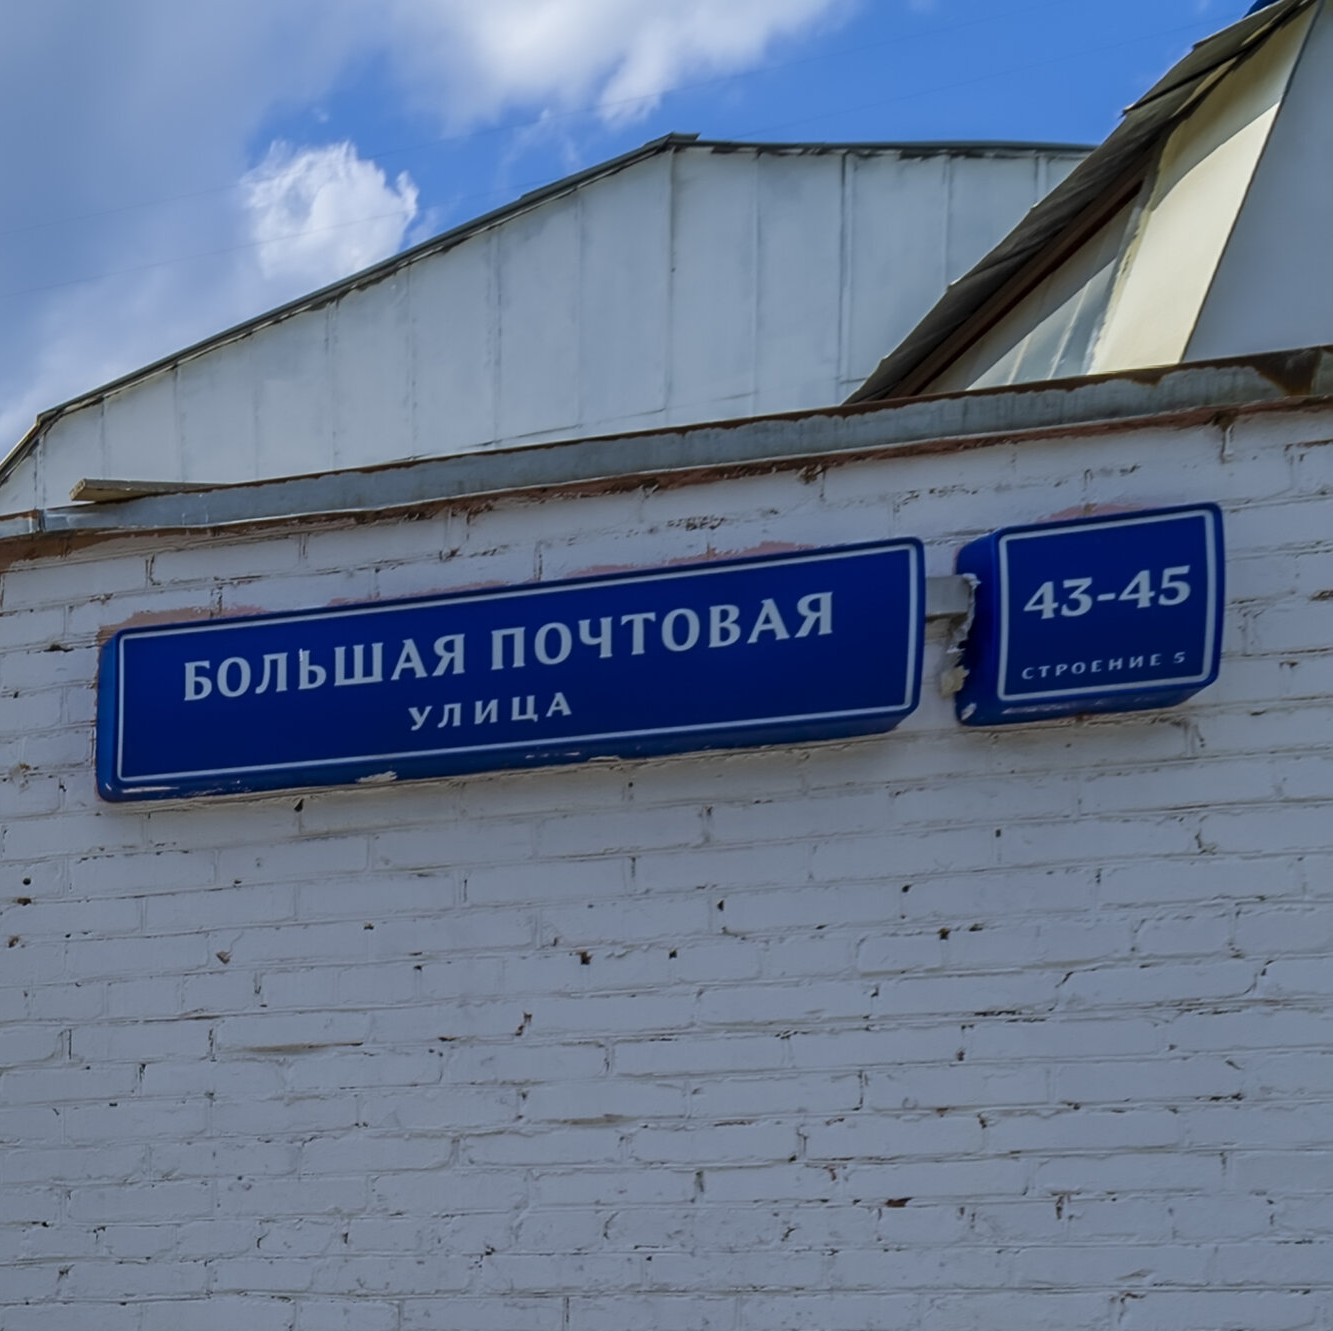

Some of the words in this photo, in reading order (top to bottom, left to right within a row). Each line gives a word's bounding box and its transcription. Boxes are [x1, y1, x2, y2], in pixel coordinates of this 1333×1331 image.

[1023, 565, 1191, 619] 43-45
[183, 634, 467, 701] БОЛЬШАЯ
[490, 592, 835, 670] ПОЧТОВАЯ
[1021, 653, 1162, 680] СТРОЕНИЕ
[1172, 651, 1186, 664] 5
[408, 692, 573, 731] УЛИЦА
